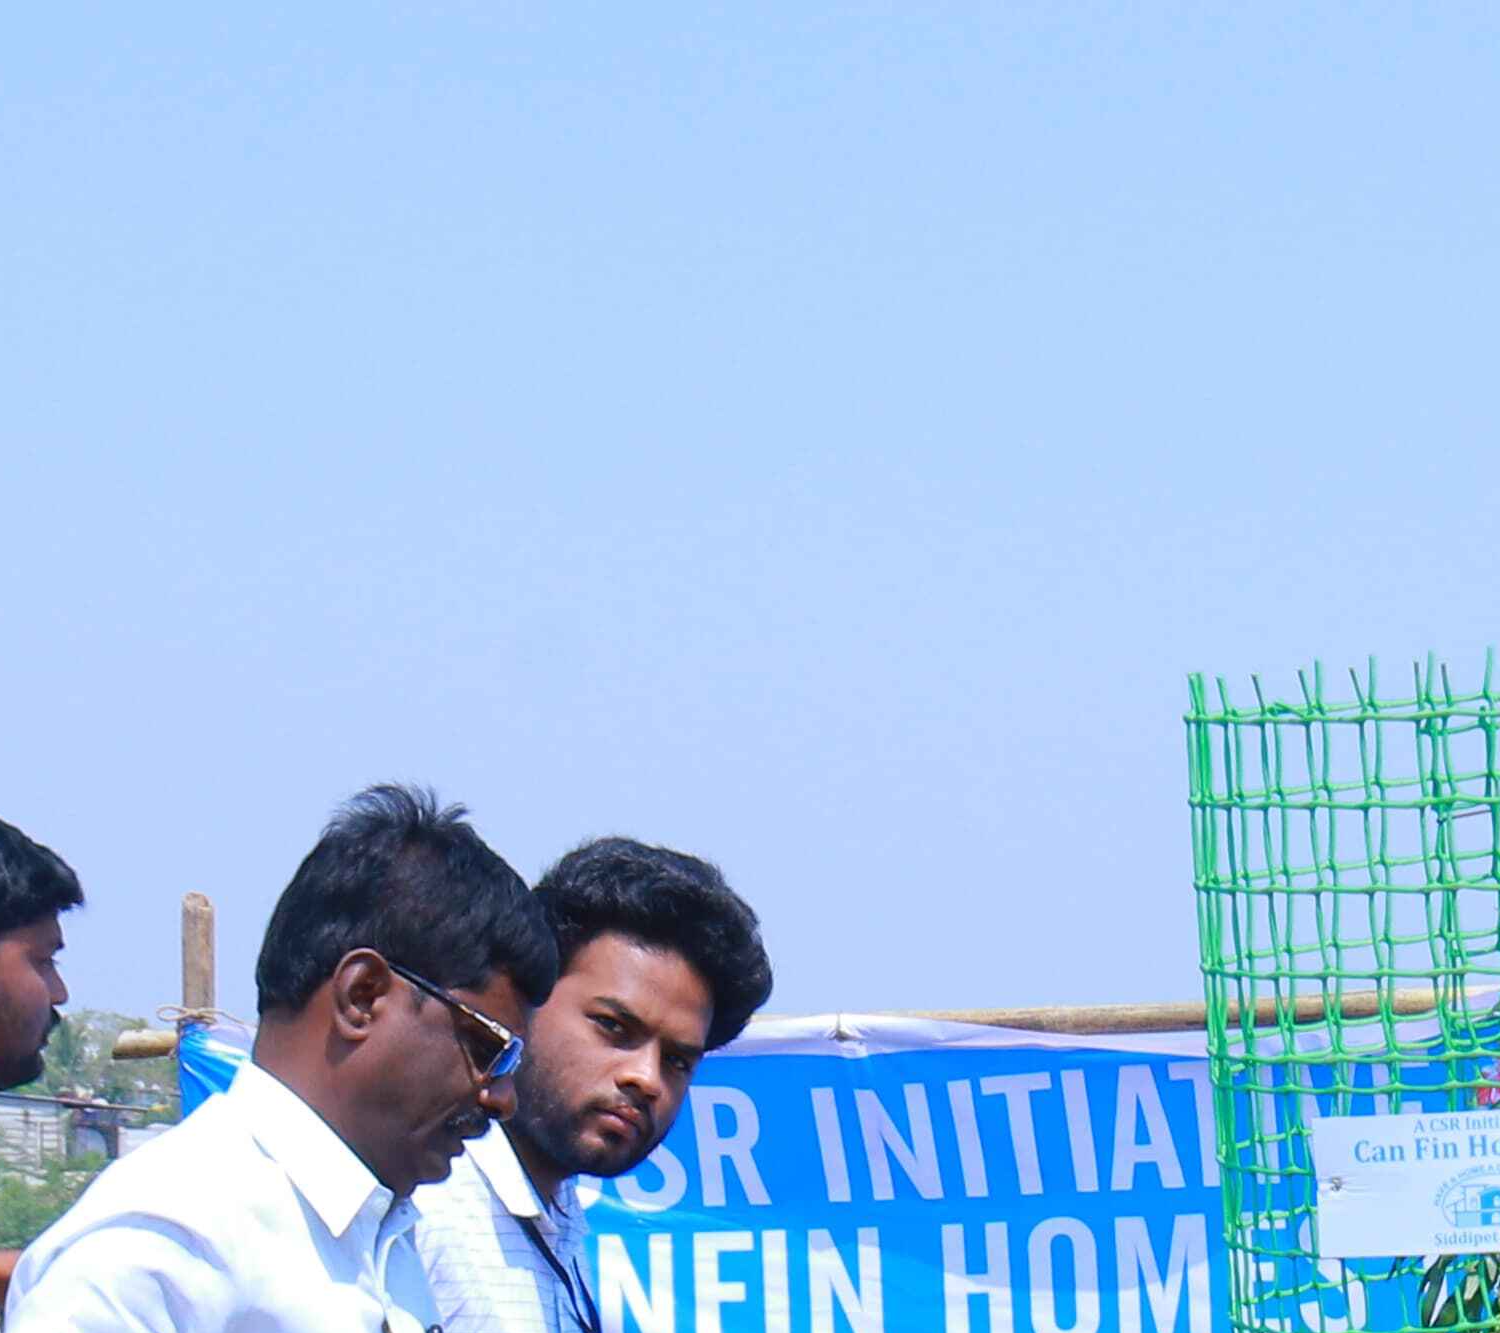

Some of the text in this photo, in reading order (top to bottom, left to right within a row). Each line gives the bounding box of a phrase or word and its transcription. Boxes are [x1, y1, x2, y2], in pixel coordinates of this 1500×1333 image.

[1414, 1119, 1425, 1134] A
[1429, 1116, 1461, 1132] CSR
[1353, 1139, 1406, 1165] Can
[1414, 1136, 1459, 1161] Fin
[1434, 1230, 1498, 1248] Siddipet
